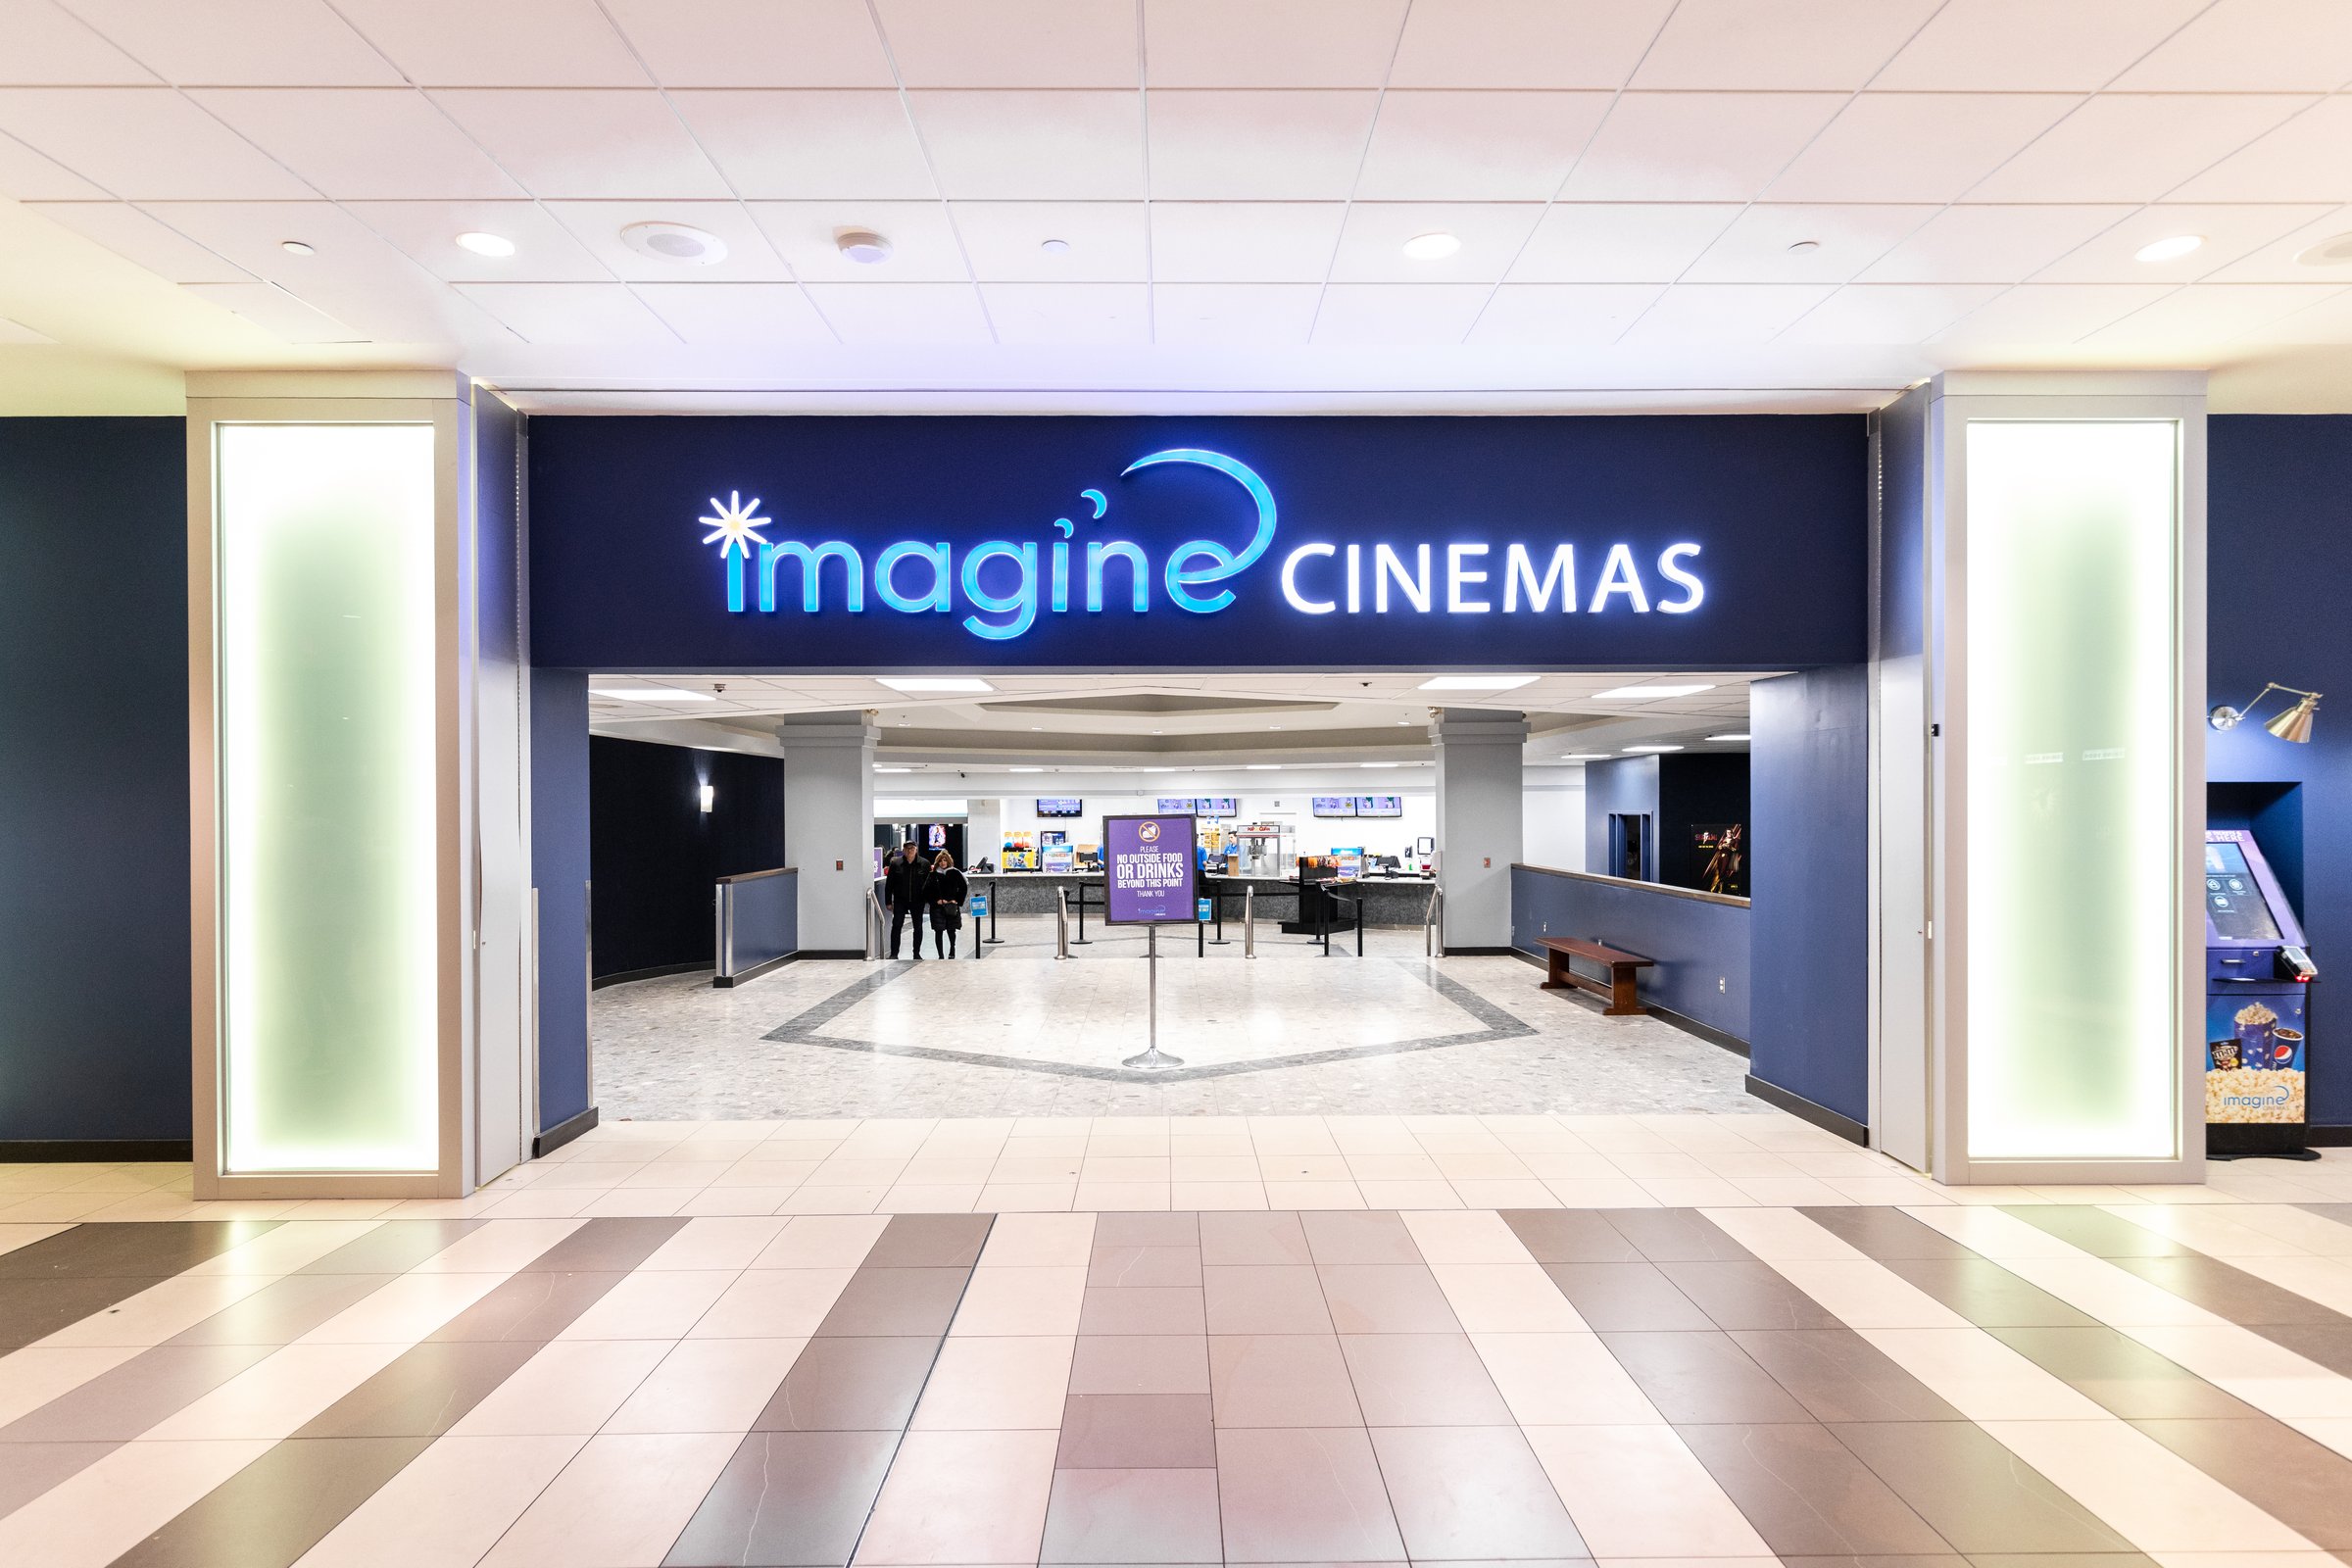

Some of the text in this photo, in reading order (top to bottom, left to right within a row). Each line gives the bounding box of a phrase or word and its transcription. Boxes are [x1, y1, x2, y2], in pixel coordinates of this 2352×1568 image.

[699, 448, 1706, 640] imagine CINEMAS
[1116, 853, 1183, 864] NO OUTSIDE FOOD
[1116, 862, 1184, 879] OR DRINKS
[1117, 878, 1183, 889] BEYOND THIS POINT
[2224, 1085, 2290, 1108] imagine
